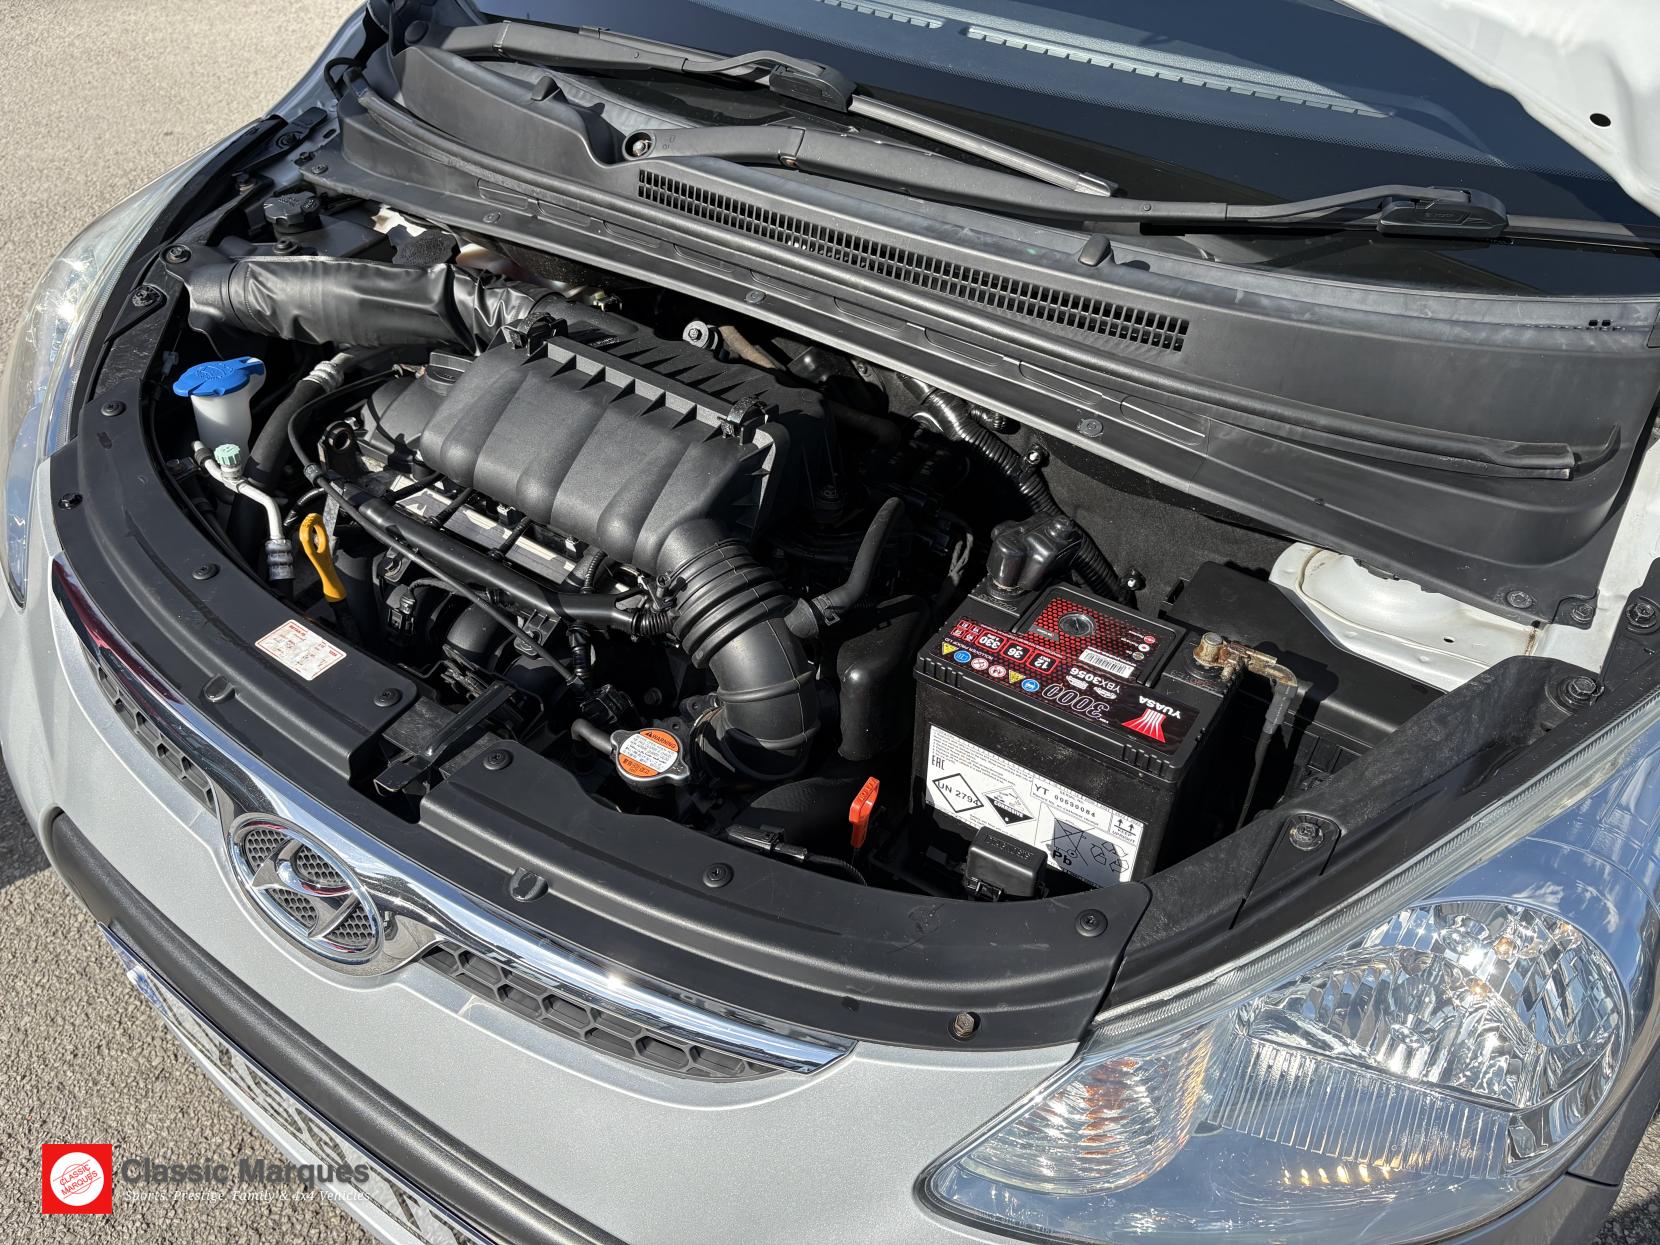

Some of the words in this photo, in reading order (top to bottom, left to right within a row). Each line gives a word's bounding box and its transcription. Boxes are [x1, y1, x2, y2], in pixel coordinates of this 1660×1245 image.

[979, 636, 1001, 649] 330
[1007, 647, 1024, 658] 36
[1034, 660, 1049, 669] 12
[1069, 667, 1120, 694] YBX3056
[1041, 683, 1110, 720] 3000
[1139, 695, 1181, 719] YUASA
[651, 733, 676, 749] WARNING
[937, 780, 953, 793] UN
[955, 789, 980, 805] 2794
[1034, 783, 1050, 795] YT
[1053, 849, 1072, 866] Pb
